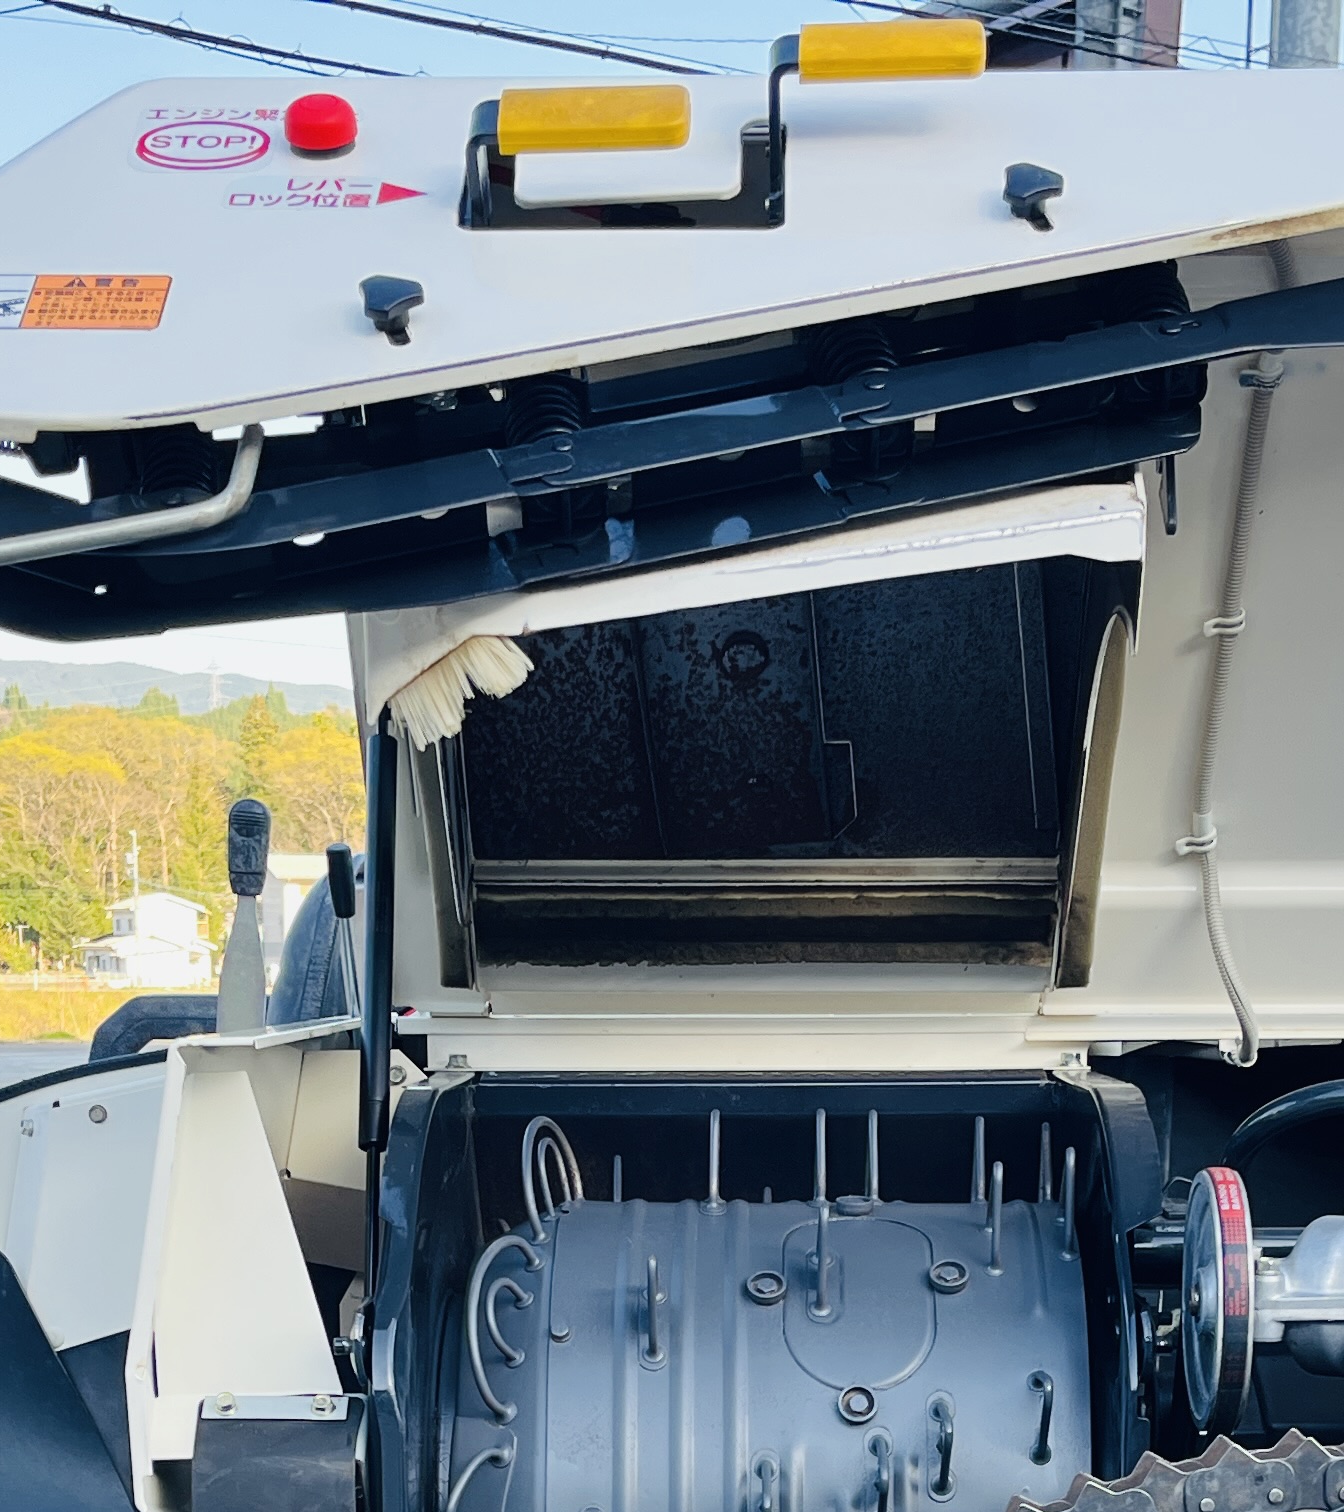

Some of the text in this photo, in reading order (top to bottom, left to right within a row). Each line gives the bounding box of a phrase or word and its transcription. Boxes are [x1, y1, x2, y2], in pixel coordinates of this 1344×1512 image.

[150, 135, 257, 149] STOP!
[287, 178, 374, 191] レバー
[228, 193, 372, 208] ロック位置
